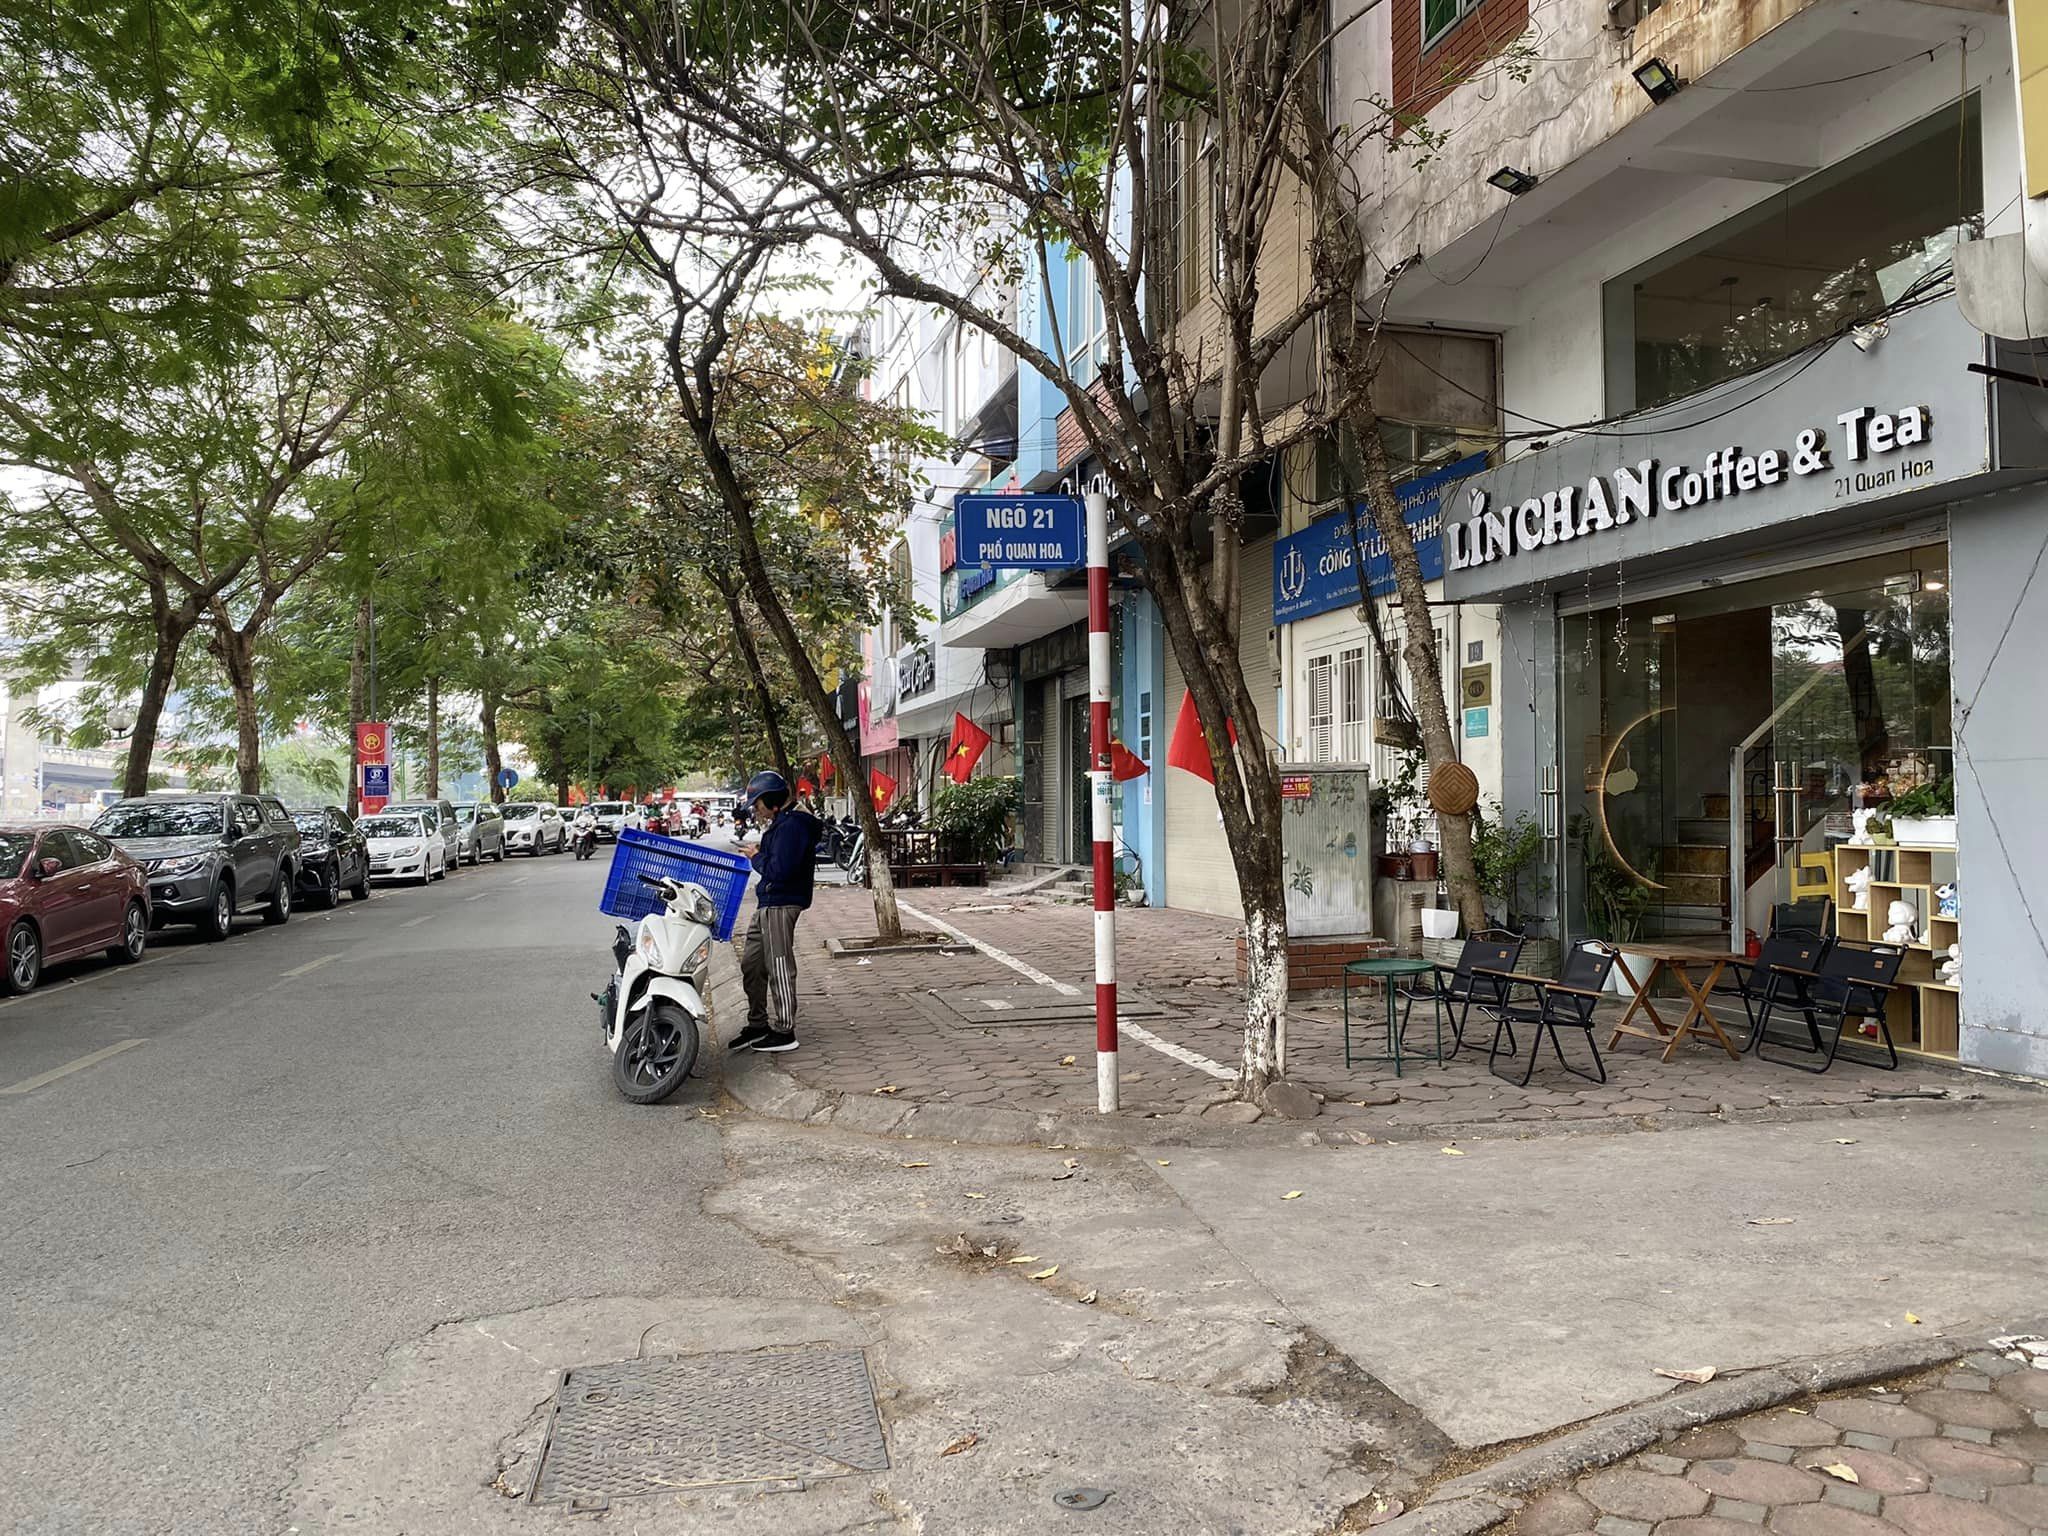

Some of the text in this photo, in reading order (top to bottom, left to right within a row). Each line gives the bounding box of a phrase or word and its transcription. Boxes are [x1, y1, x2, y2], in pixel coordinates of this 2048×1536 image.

[1661, 446, 1781, 511] Coffee
[1792, 428, 1826, 476] &
[1837, 405, 1924, 461] Tea
[1834, 458, 1934, 498] 21 Quan Hoa
[986, 502, 1054, 529] NGÕ 21
[979, 537, 1063, 561] PHỐ QUAN HOA
[1319, 547, 1351, 577] CÔNG
